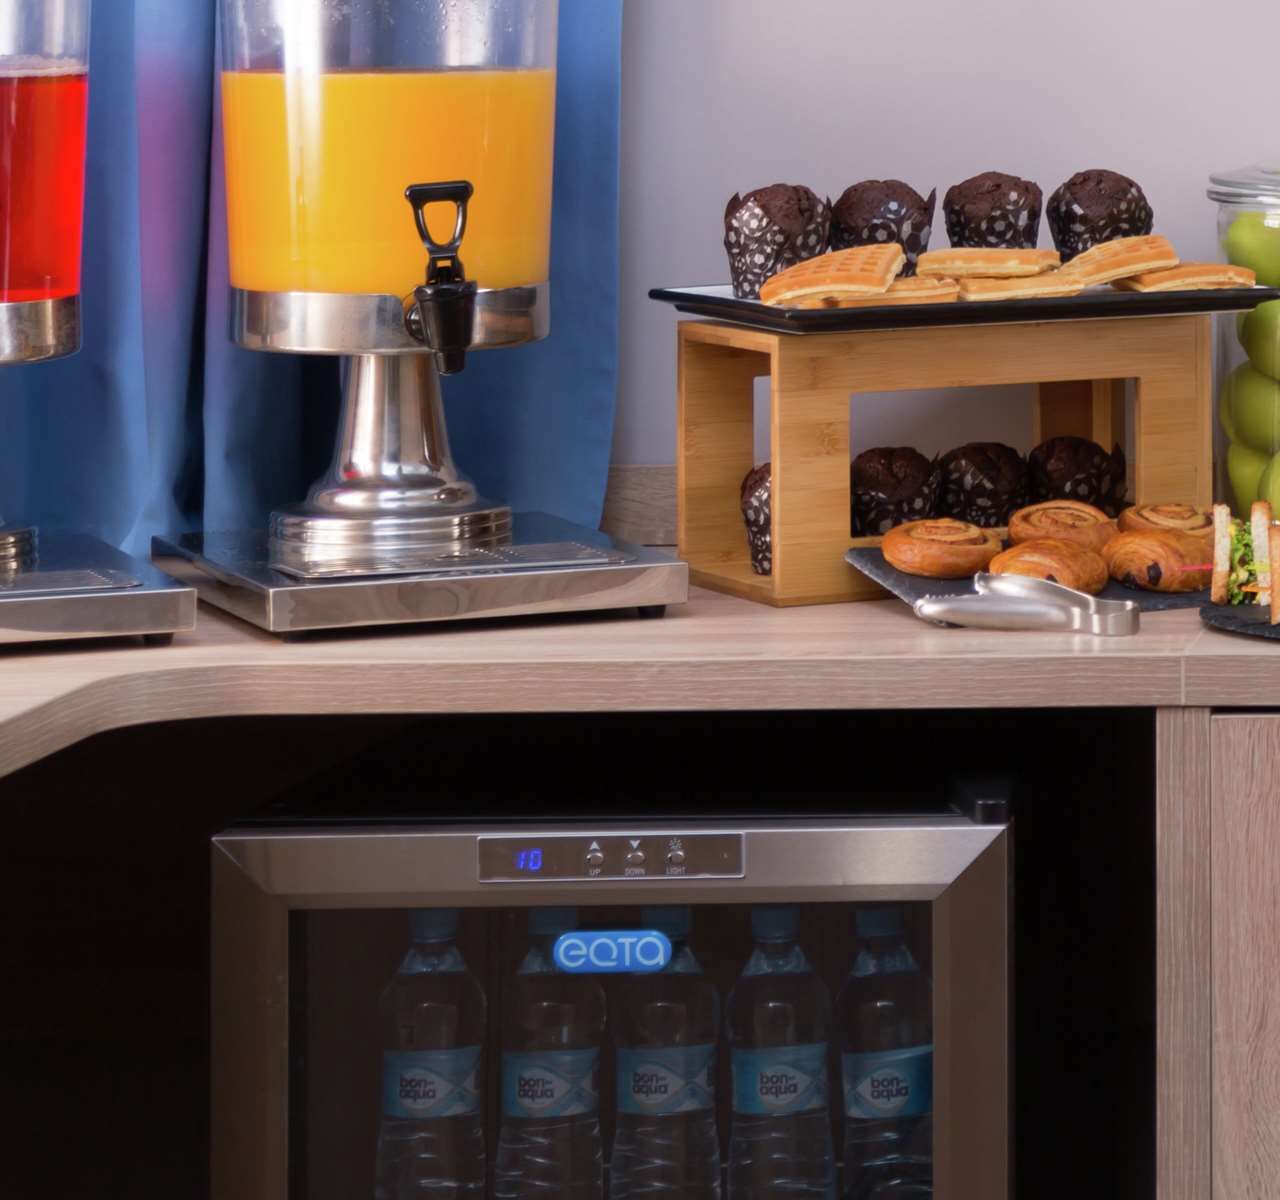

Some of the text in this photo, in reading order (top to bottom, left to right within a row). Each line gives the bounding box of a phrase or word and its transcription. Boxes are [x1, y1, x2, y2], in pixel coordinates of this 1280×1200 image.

[515, 848, 543, 871] 10
[666, 866, 686, 874] LIGHT
[399, 1088, 436, 1101] aqua
[518, 1089, 554, 1101] aqua
[632, 1084, 667, 1097] aqua
[759, 1085, 797, 1098] aqua
[870, 1088, 909, 1101] aqua
